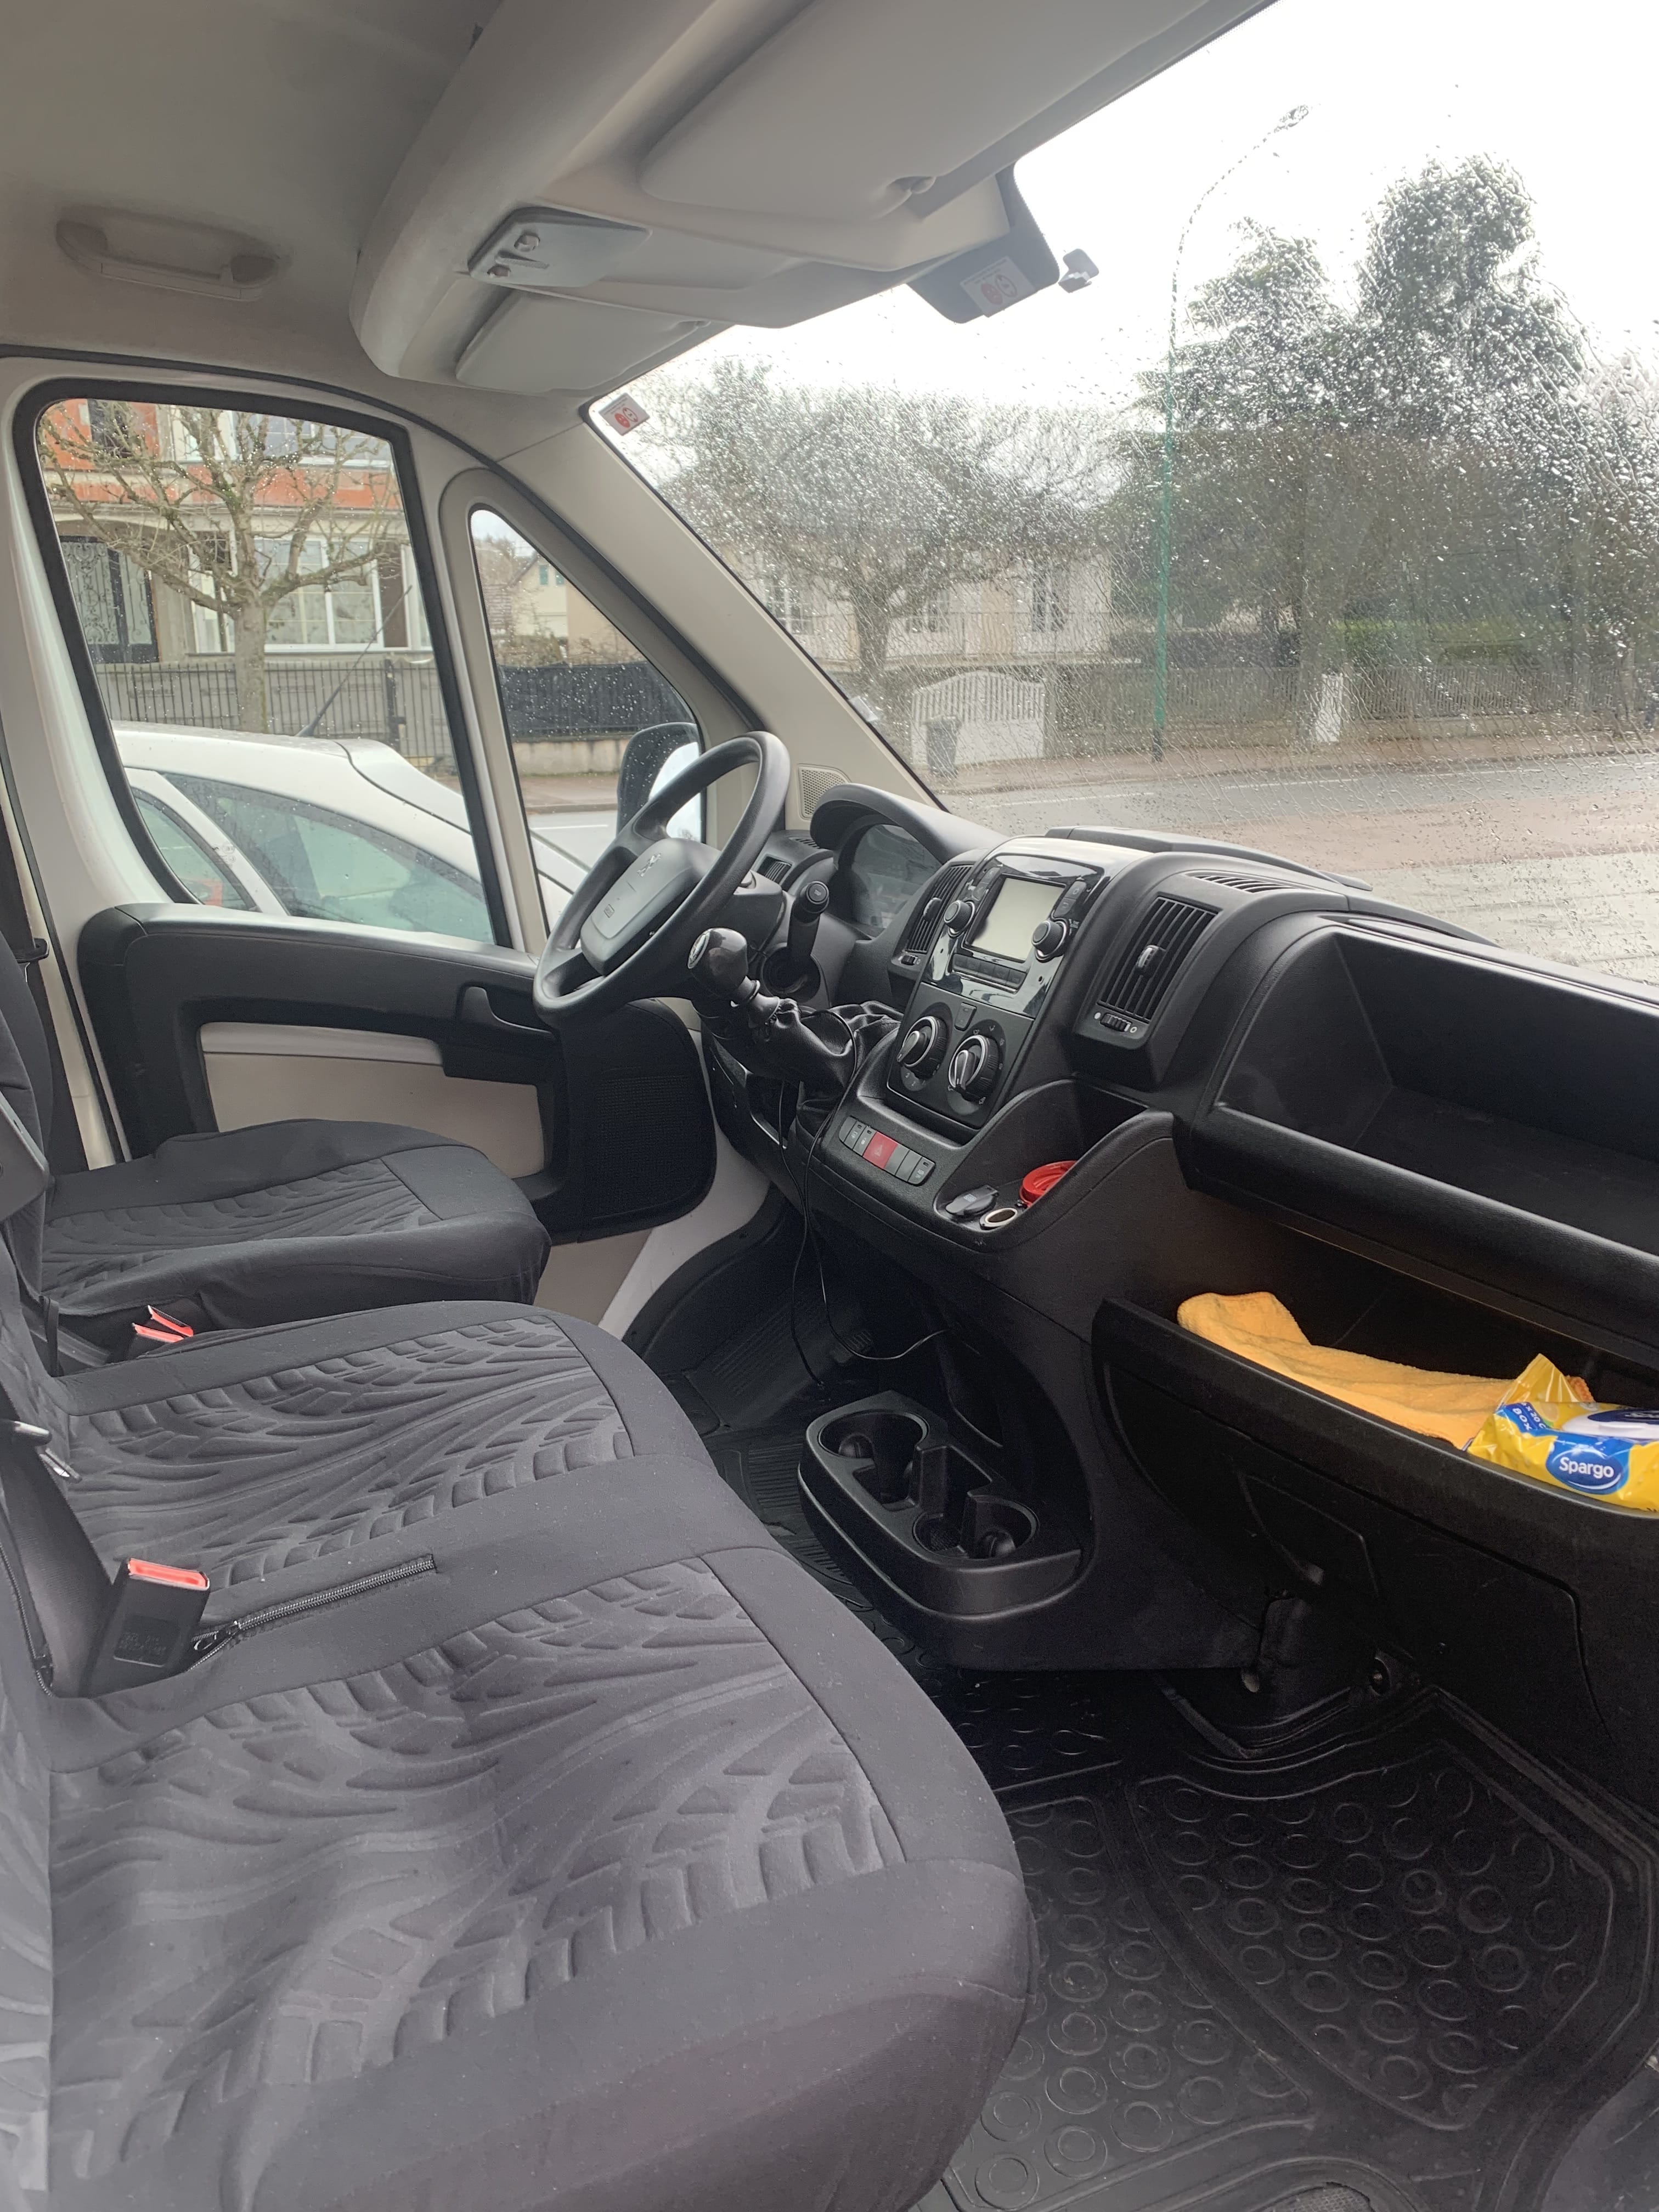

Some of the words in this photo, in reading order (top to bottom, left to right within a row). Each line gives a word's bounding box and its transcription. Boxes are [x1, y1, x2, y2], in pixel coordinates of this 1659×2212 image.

[1513, 1408, 1532, 1430] BOX
[1530, 1412, 1541, 1422] 20
[1559, 1457, 1614, 1479] Spargo
